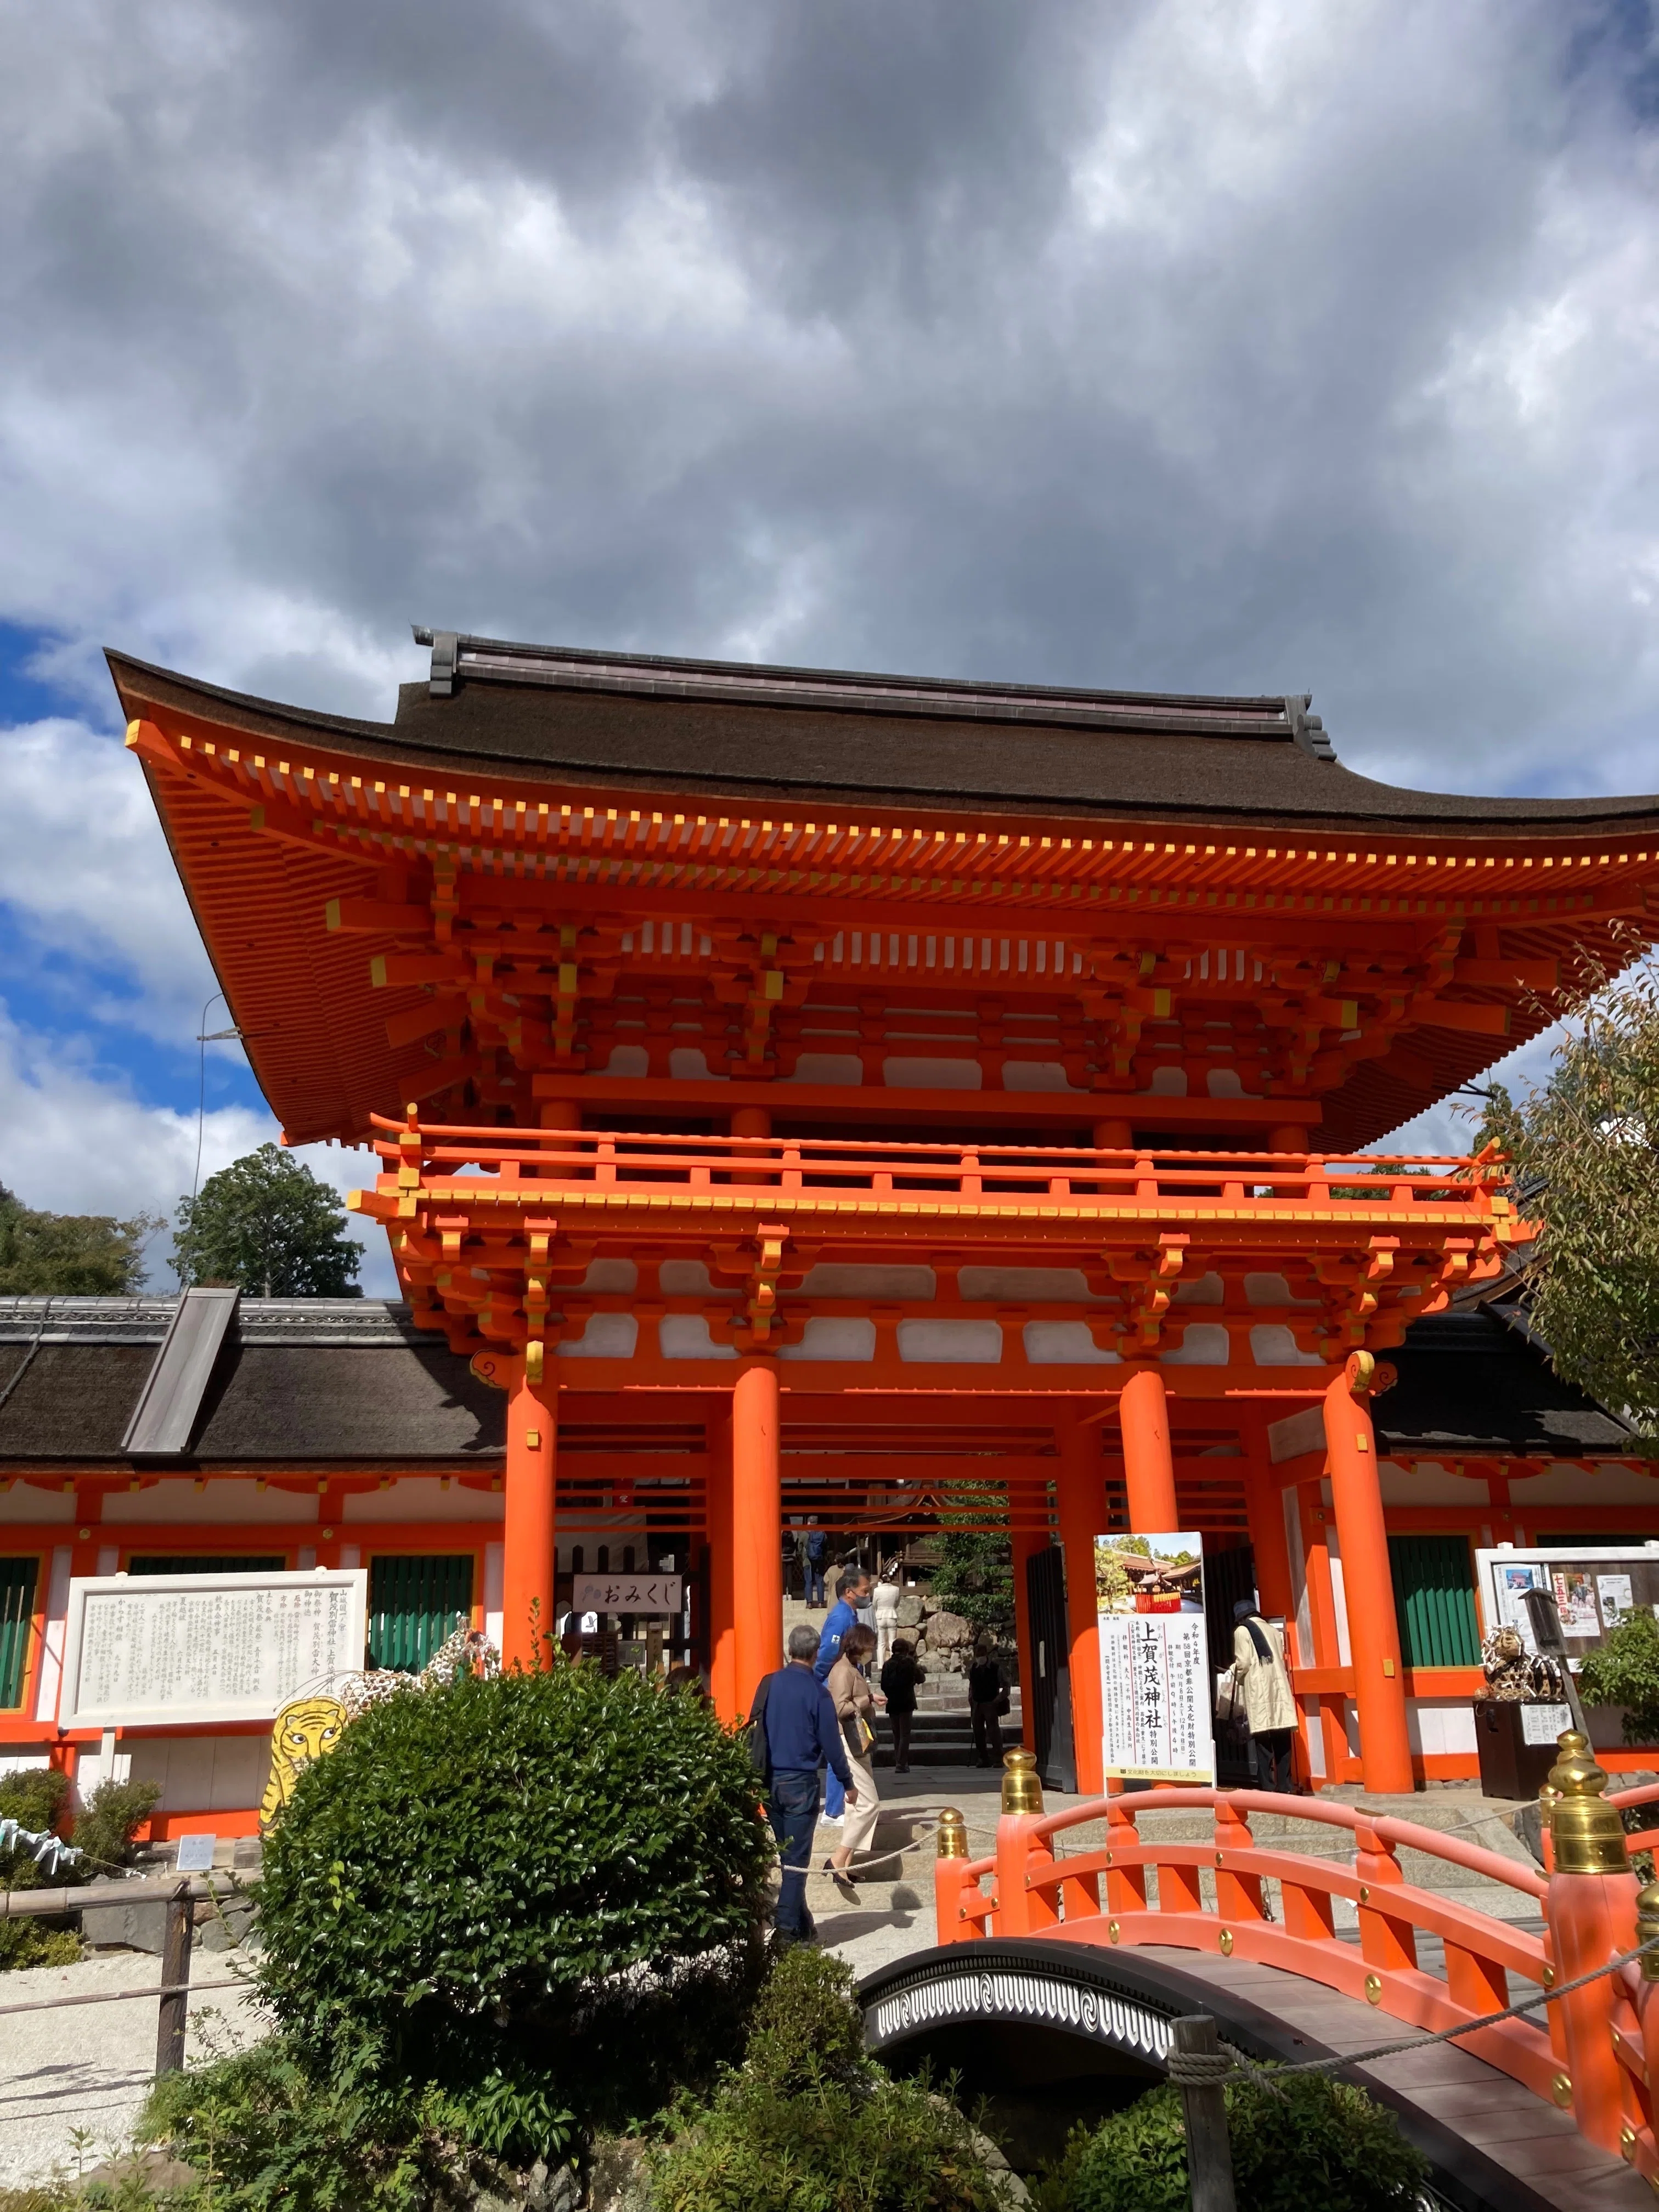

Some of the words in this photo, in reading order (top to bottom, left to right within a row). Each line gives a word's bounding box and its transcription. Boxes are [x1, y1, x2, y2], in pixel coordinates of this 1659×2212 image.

[280, 1595, 287, 1608] 方除
[294, 1595, 301, 1607] 厄除
[314, 1590, 322, 1616] 御祭神
[338, 1589, 347, 1631] 山城国一ノ宮
[605, 1582, 676, 1605] おみくじ
[311, 1622, 320, 1678] 賀茂別雷大神
[1191, 1622, 1200, 1664] 令和4年度
[1141, 1621, 1163, 1729] 上賀茂神社
[1183, 1633, 1197, 1767] 第58回京都非公開文化財特別公開
[1149, 1730, 1158, 1765] 特別公開
